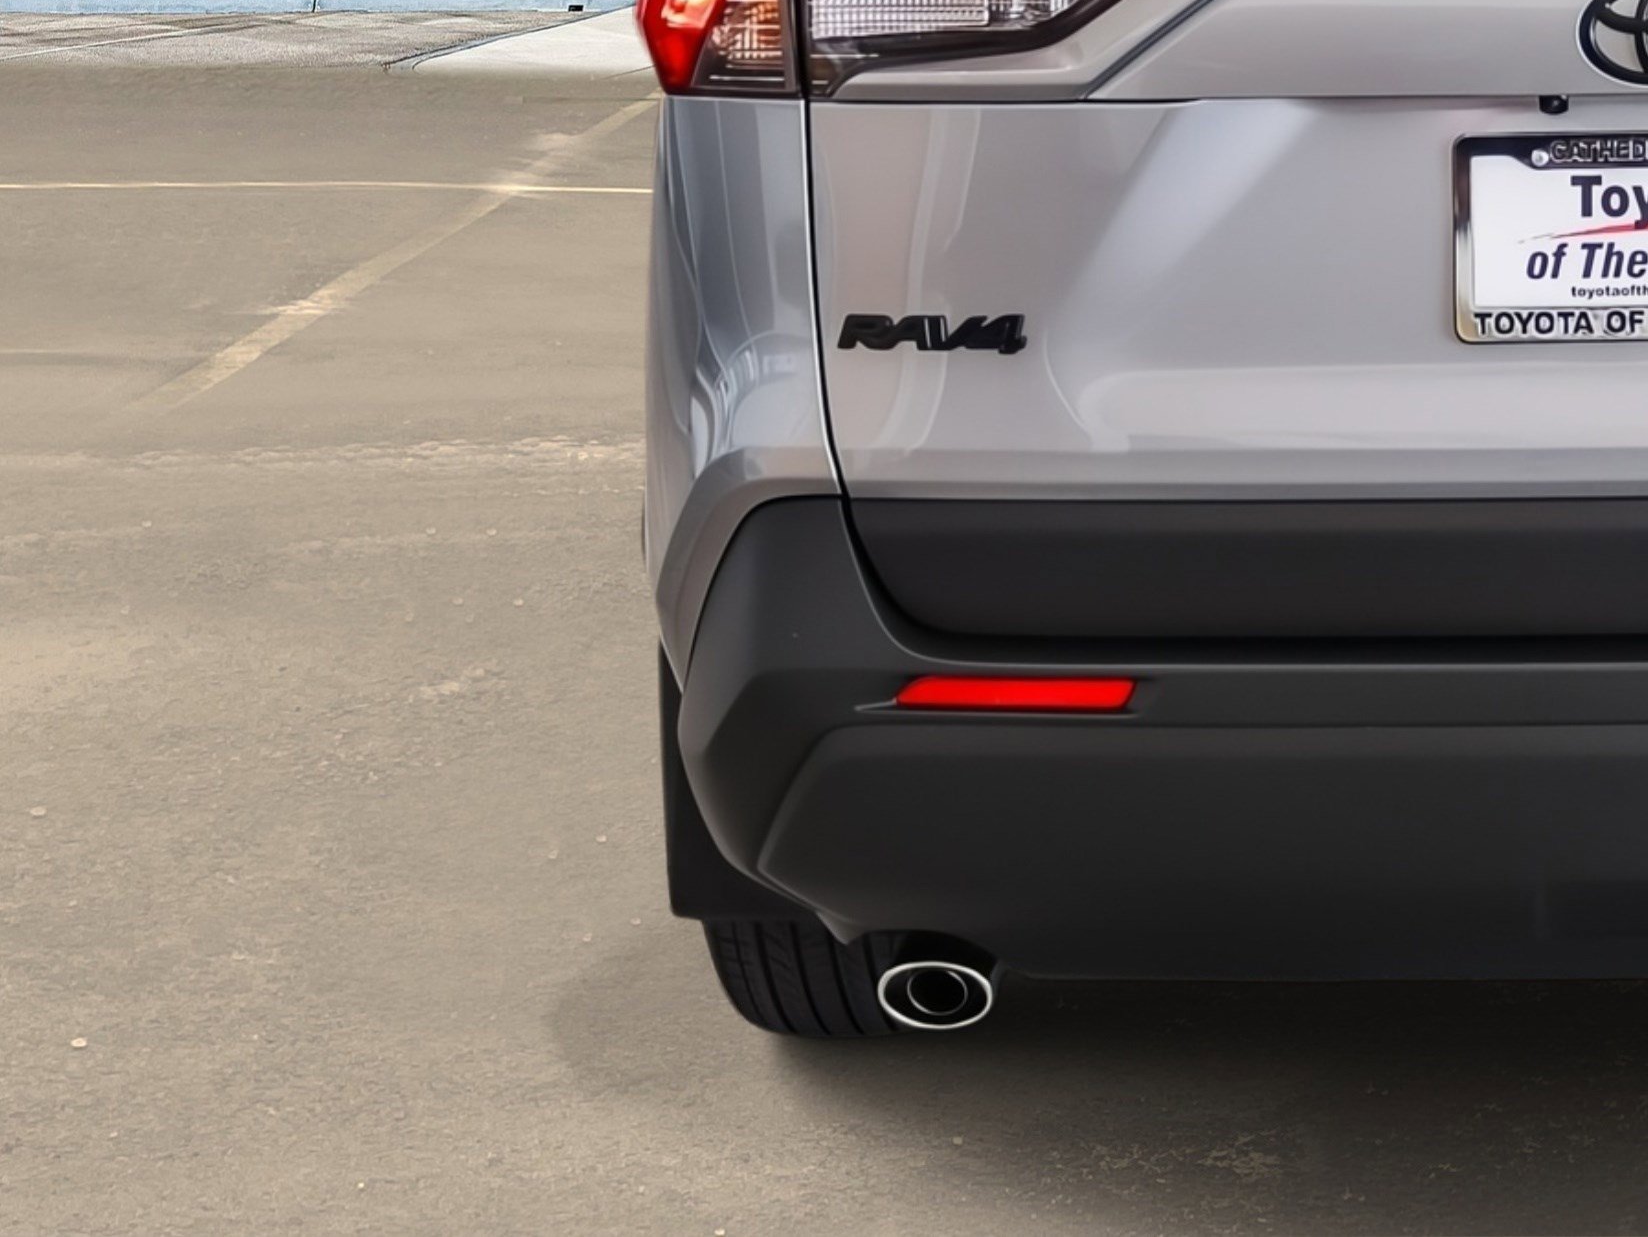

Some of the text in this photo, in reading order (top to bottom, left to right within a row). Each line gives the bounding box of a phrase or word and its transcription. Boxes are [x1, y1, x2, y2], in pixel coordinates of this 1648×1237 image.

[1526, 242, 1569, 280] of
[1580, 243, 1648, 279] The
[837, 313, 1028, 355] RAV4
[1475, 311, 1594, 335] TOYOTA
[1605, 310, 1646, 335] OF
